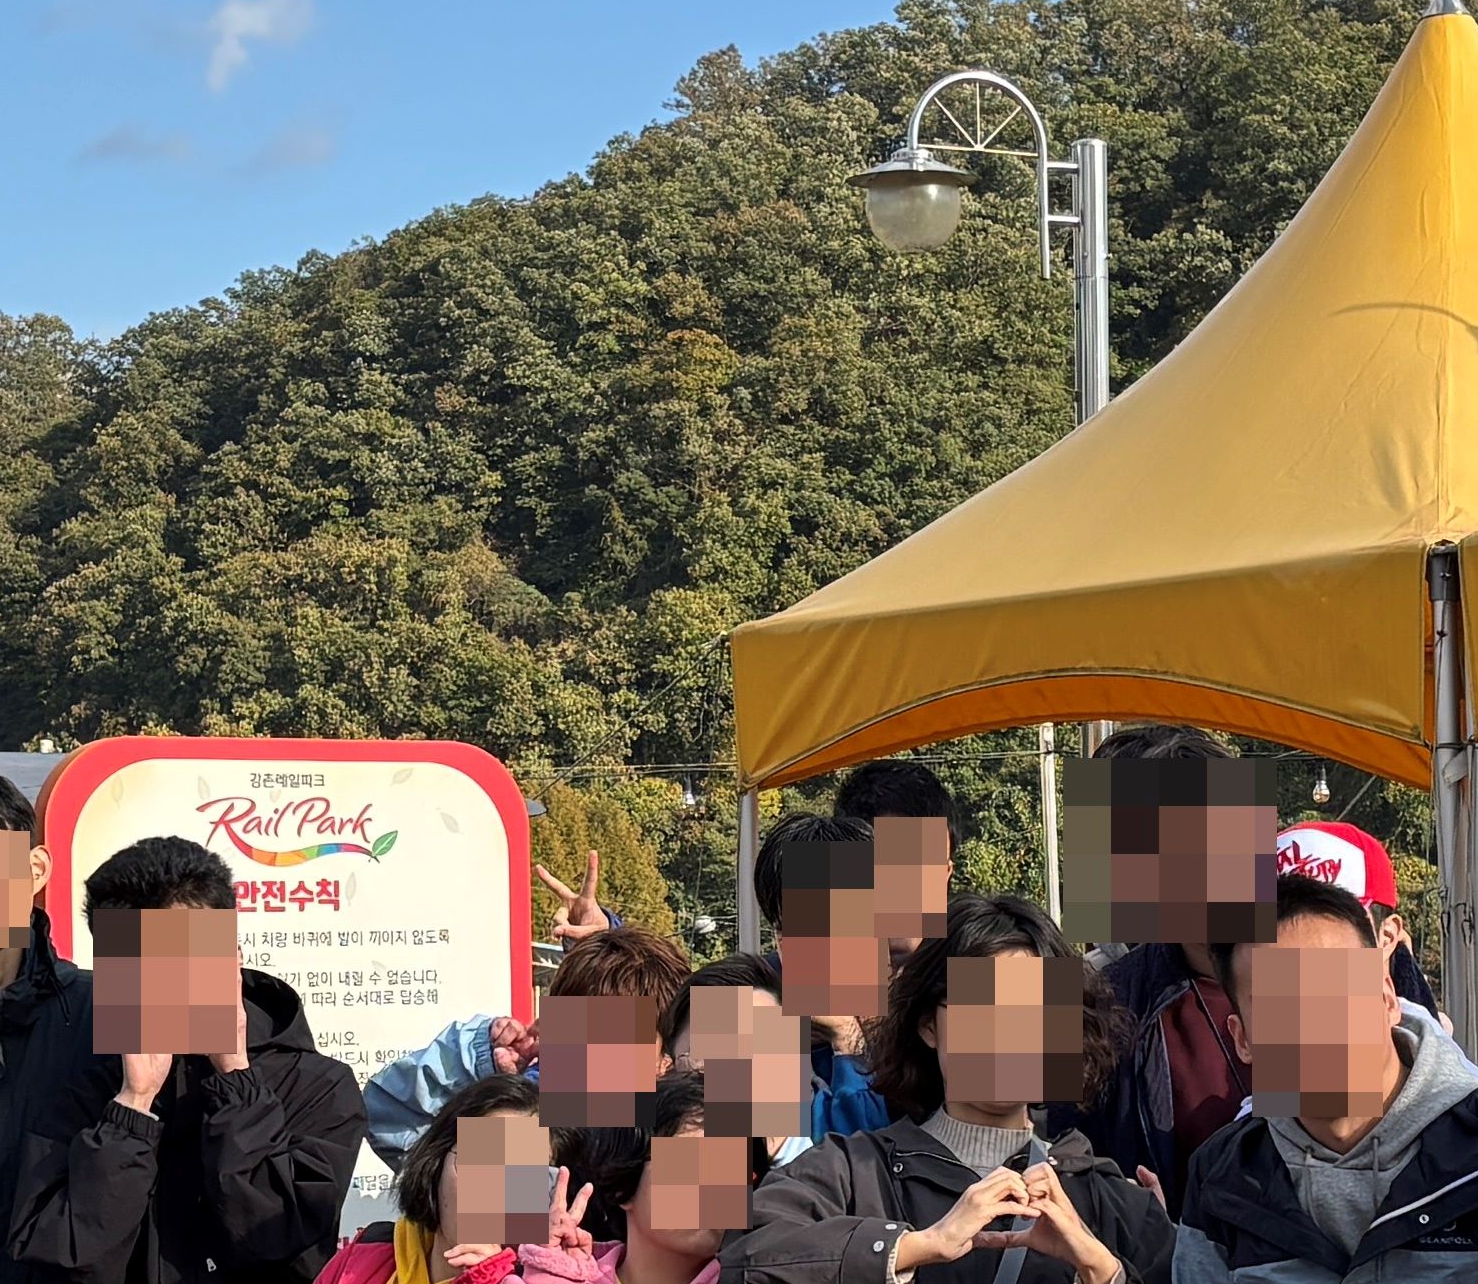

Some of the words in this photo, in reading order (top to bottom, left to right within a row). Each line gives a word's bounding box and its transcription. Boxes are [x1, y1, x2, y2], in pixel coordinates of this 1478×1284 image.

[250, 772, 325, 789] 강촌레일파크
[195, 796, 294, 847] Rail
[292, 796, 373, 844] Park
[234, 878, 340, 913] 안전수칙
[306, 971, 333, 988] 없이
[368, 970, 382, 986] 수
[386, 969, 442, 986] 없습니다.
[311, 991, 337, 1007] 따라
[343, 990, 396, 1007] 순서대로
